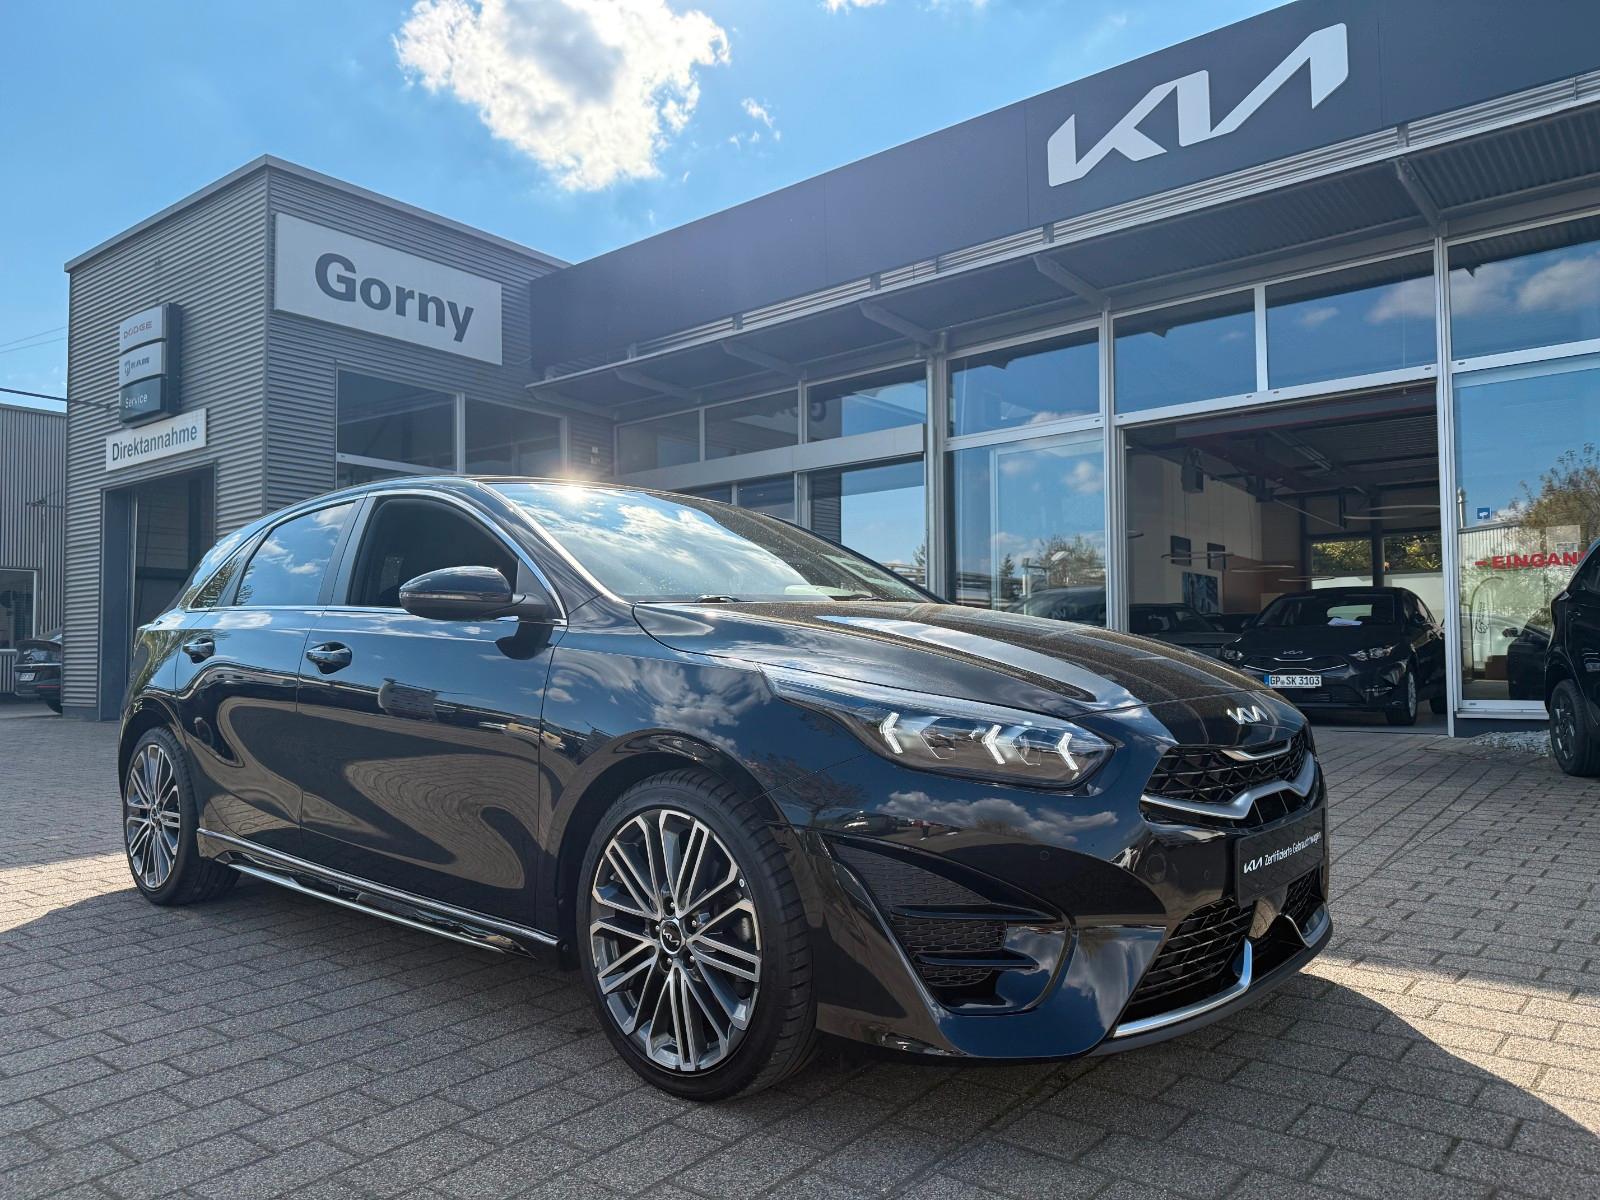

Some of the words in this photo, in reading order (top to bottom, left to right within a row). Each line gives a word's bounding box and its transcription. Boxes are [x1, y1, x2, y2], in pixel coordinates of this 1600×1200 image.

[1047, 22, 1348, 187] KIA
[314, 252, 474, 342] Gorny
[123, 320, 152, 339] DODGE
[131, 356, 150, 369] RAM
[125, 393, 148, 408] Service
[112, 425, 198, 461] Direktannahme
[1270, 676, 1281, 685] GP
[1286, 676, 1297, 685] SK
[1299, 676, 1320, 685] 3103
[1243, 857, 1263, 874] KIA
[1264, 847, 1292, 866] Zertifizierte
